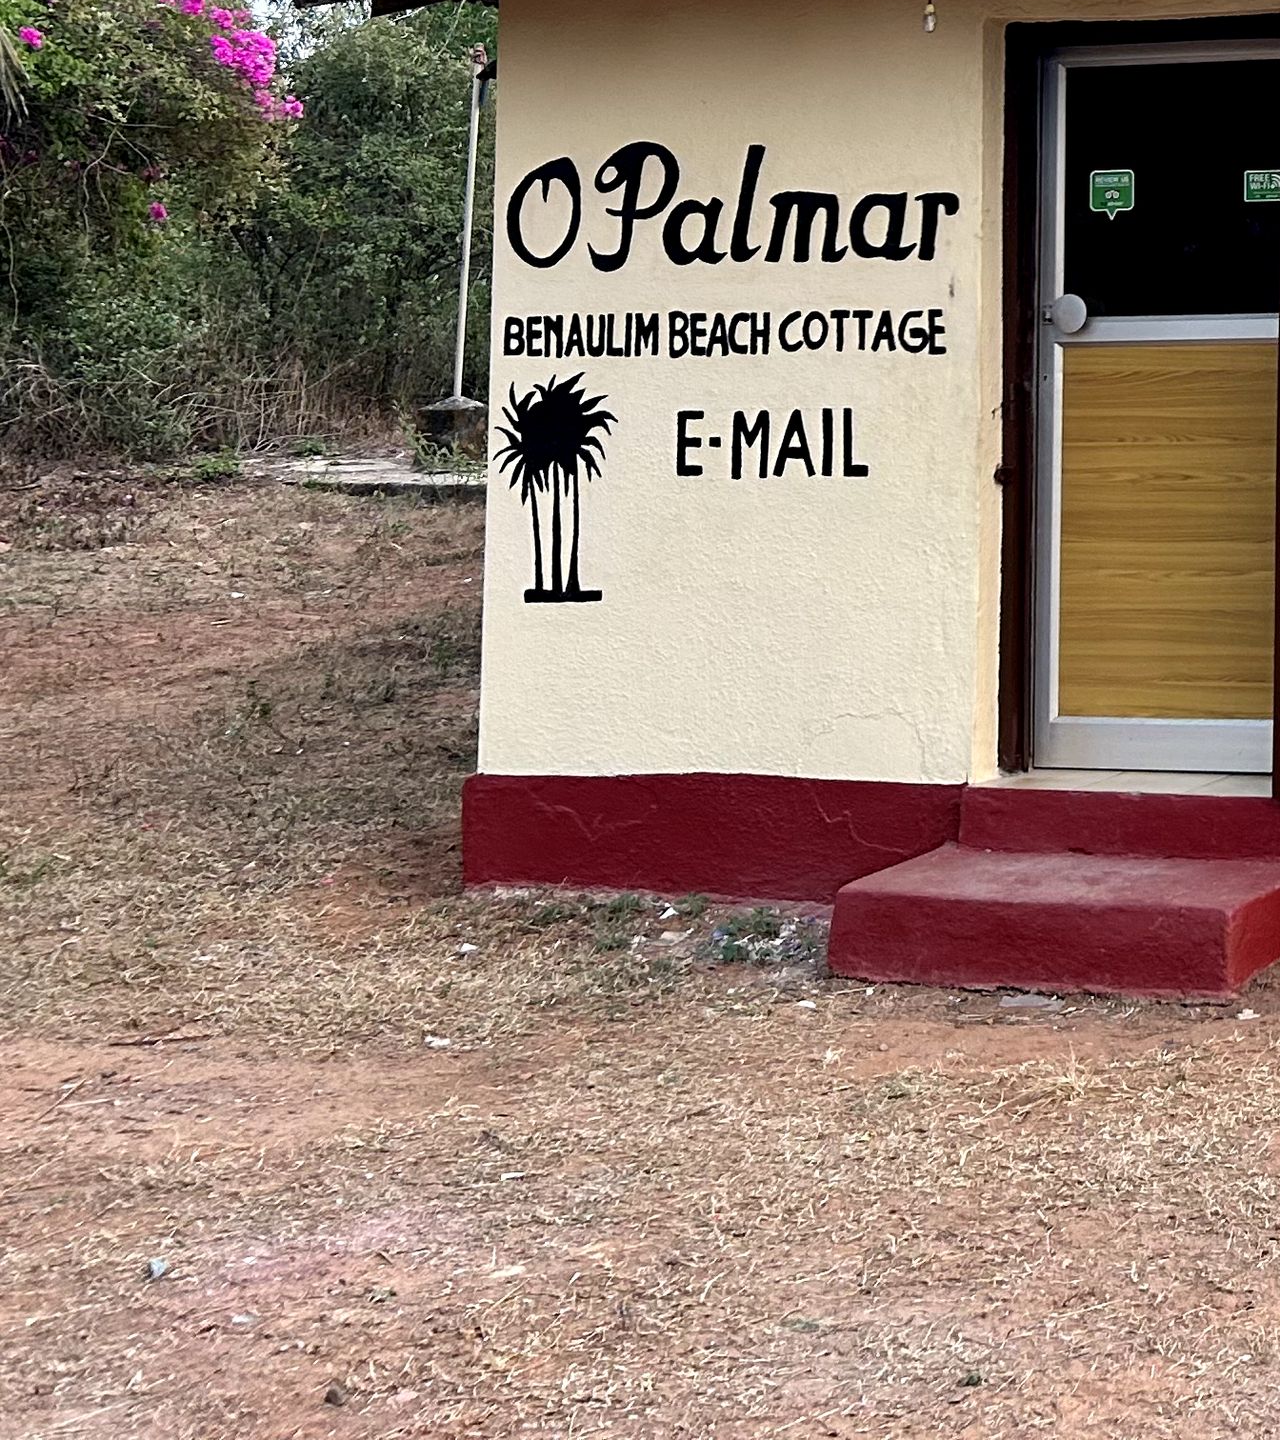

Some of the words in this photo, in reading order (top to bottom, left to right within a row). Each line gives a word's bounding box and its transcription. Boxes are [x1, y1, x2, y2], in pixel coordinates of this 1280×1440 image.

[506, 156, 582, 269] O
[587, 141, 960, 273] Palmar
[1249, 173, 1271, 182] FREE
[503, 313, 660, 358] BENAULIM
[668, 310, 771, 358] BEACH
[778, 309, 947, 355] COTTAGE
[676, 407, 869, 480] E-MAIL
